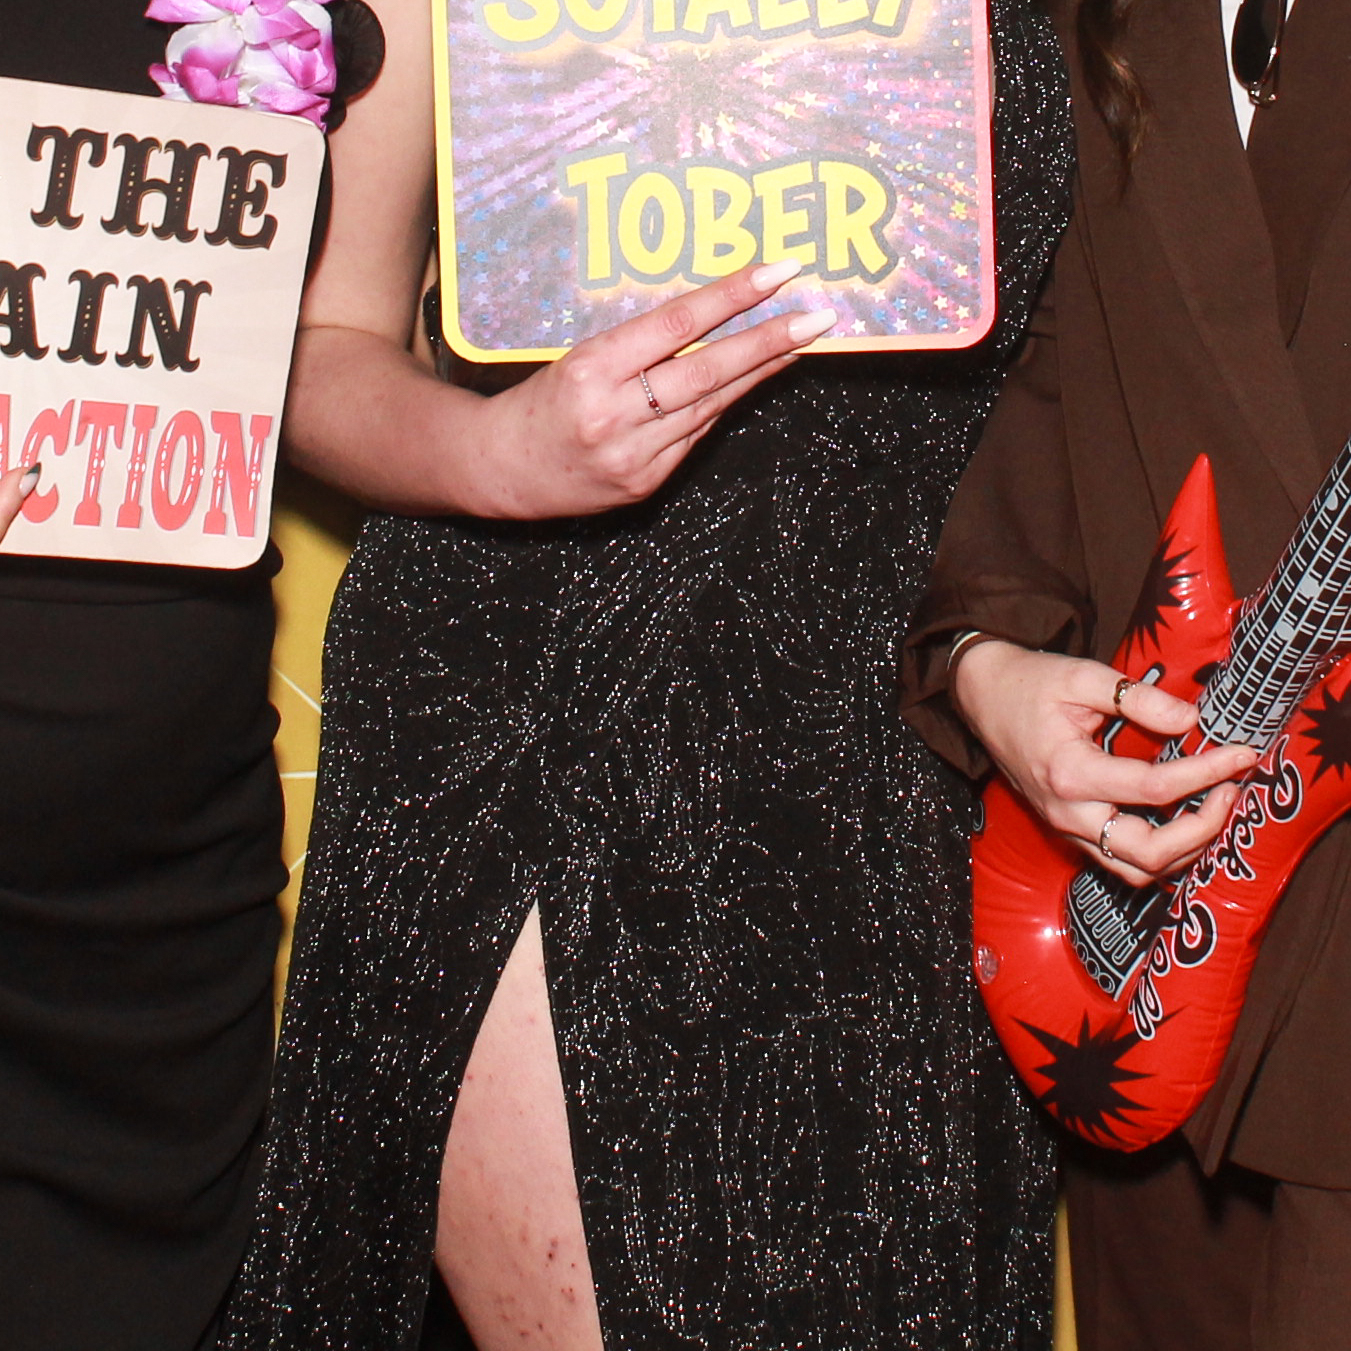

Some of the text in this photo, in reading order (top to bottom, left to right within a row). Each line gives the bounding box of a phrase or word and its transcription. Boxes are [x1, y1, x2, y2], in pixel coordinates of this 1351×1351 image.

[25, 121, 289, 251] THE
[563, 150, 901, 283] TOBER
[1212, 734, 1303, 881] Rock
[1127, 889, 1218, 1040] Roll
